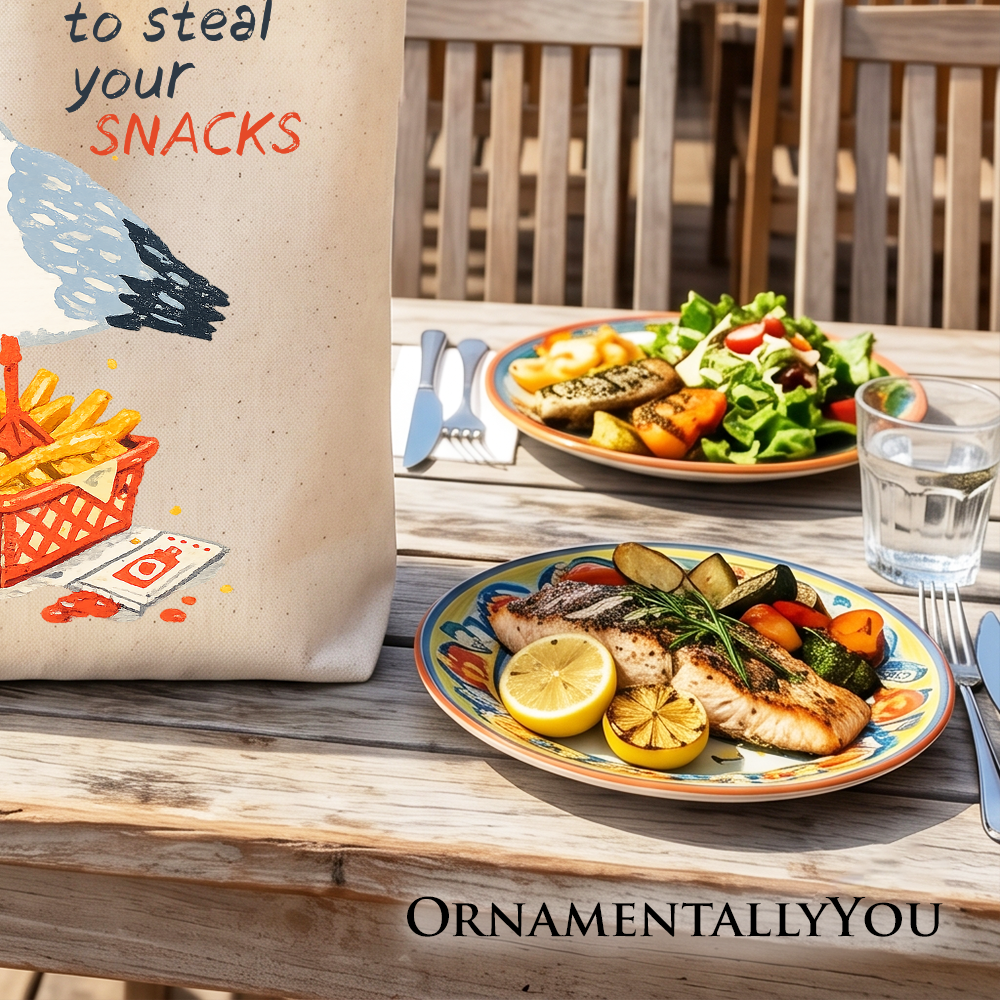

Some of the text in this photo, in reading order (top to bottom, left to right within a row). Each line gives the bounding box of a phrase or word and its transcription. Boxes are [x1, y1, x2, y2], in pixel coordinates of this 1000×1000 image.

[64, 1, 122, 43] to
[65, 60, 196, 113] your
[89, 110, 302, 156] SNACKS
